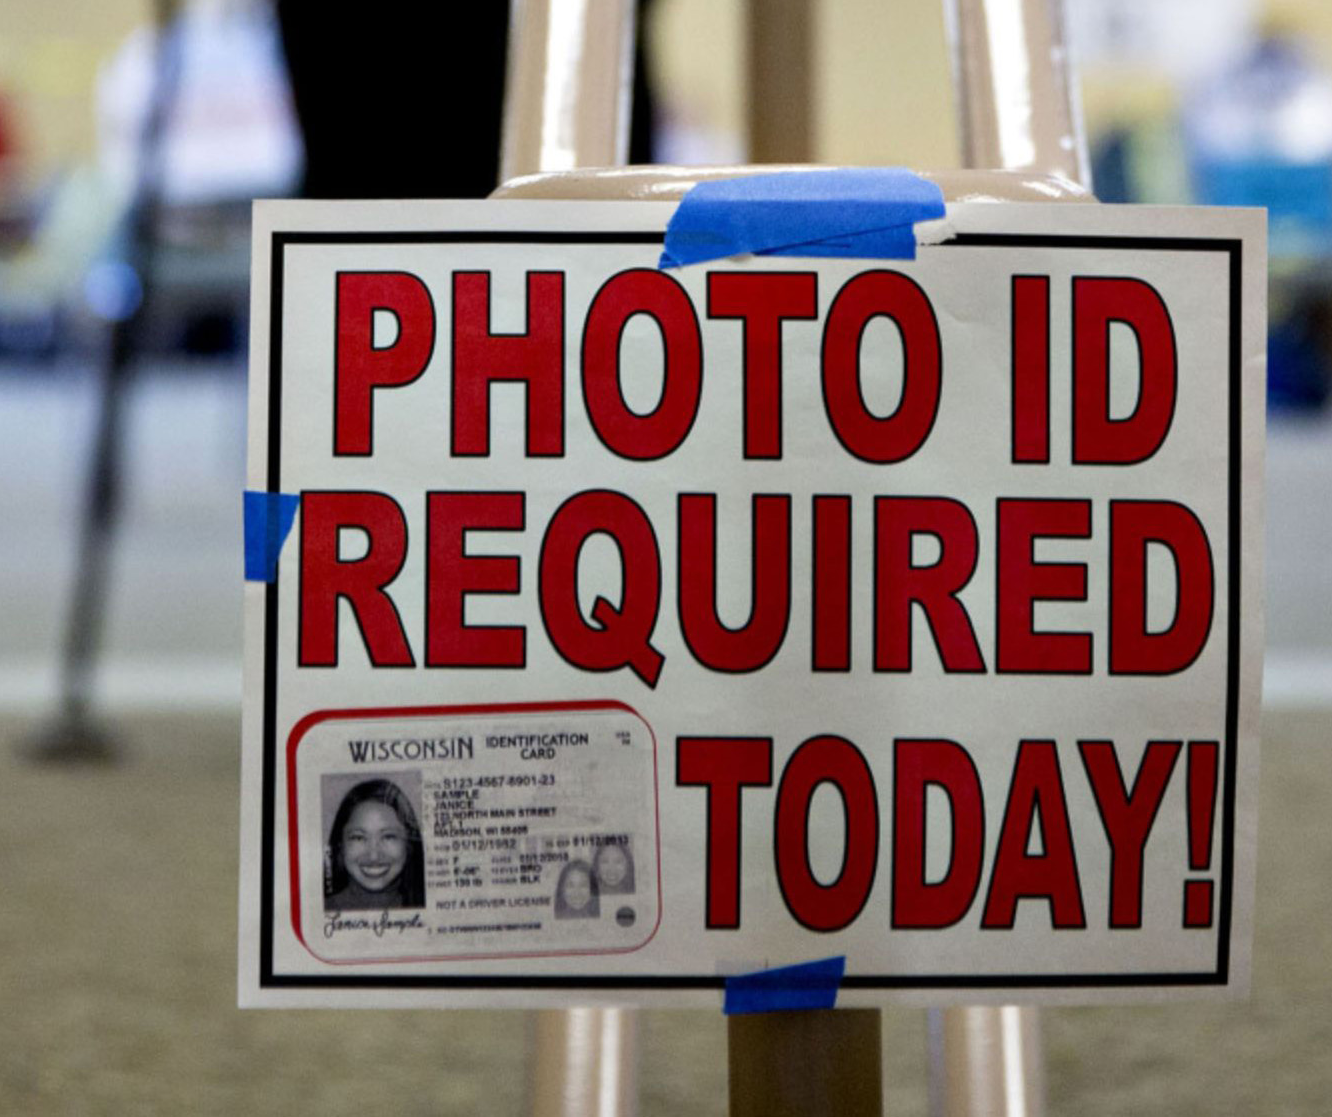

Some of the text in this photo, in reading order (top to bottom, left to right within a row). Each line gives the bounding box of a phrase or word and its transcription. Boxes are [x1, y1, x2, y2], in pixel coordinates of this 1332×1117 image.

[334, 268, 1178, 465] PHOTO ID
[298, 489, 1215, 689] REQUIRED
[348, 737, 473, 763] WISCONSIN
[486, 733, 589, 748] IDENTIFICATION
[520, 747, 556, 760] CARD
[676, 733, 1220, 932] TODAY!
